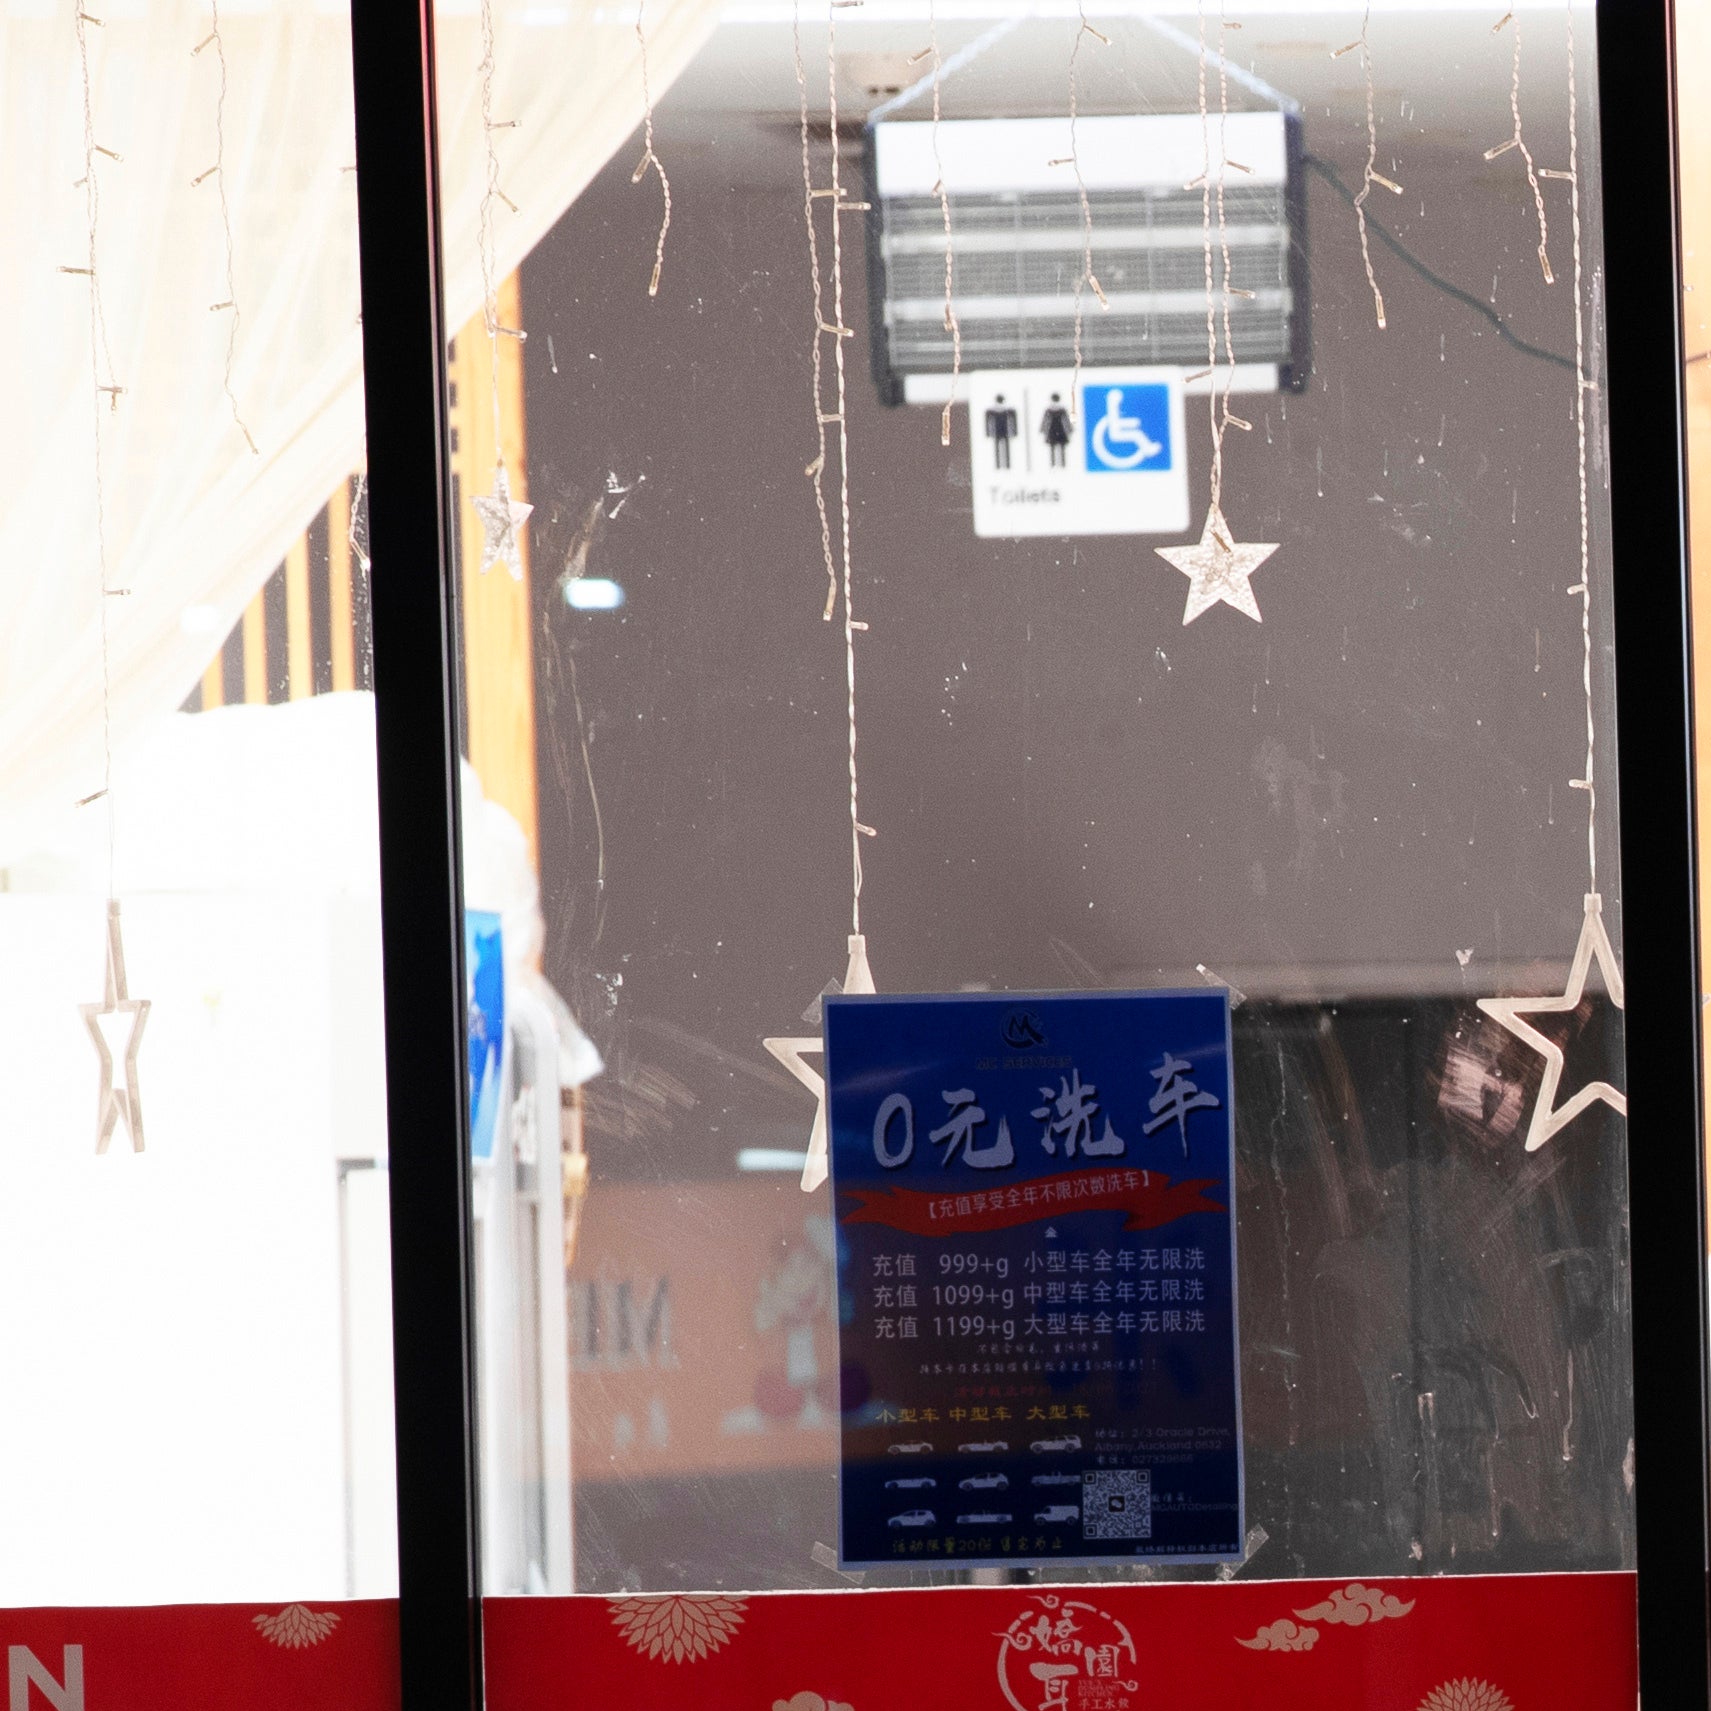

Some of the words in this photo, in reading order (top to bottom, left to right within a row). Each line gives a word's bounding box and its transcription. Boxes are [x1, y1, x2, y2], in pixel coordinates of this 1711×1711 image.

[988, 485, 1061, 506] Toilets
[873, 1254, 917, 1277] 充值
[939, 1255, 1009, 1278] 999+g
[1024, 1249, 1205, 1273] 小型车全年无限洗
[873, 1285, 917, 1308] 充值
[933, 1284, 1014, 1308] 1099+g
[1024, 1279, 1205, 1303] 中型车全年无限洗
[875, 1316, 918, 1339] 充值
[933, 1315, 1015, 1339] 1199+g
[1024, 1310, 1205, 1335] 大型车全年无限洗
[875, 1408, 940, 1423] 小型车
[949, 1406, 1012, 1422] 中型车
[1026, 1404, 1091, 1421] 大型车
